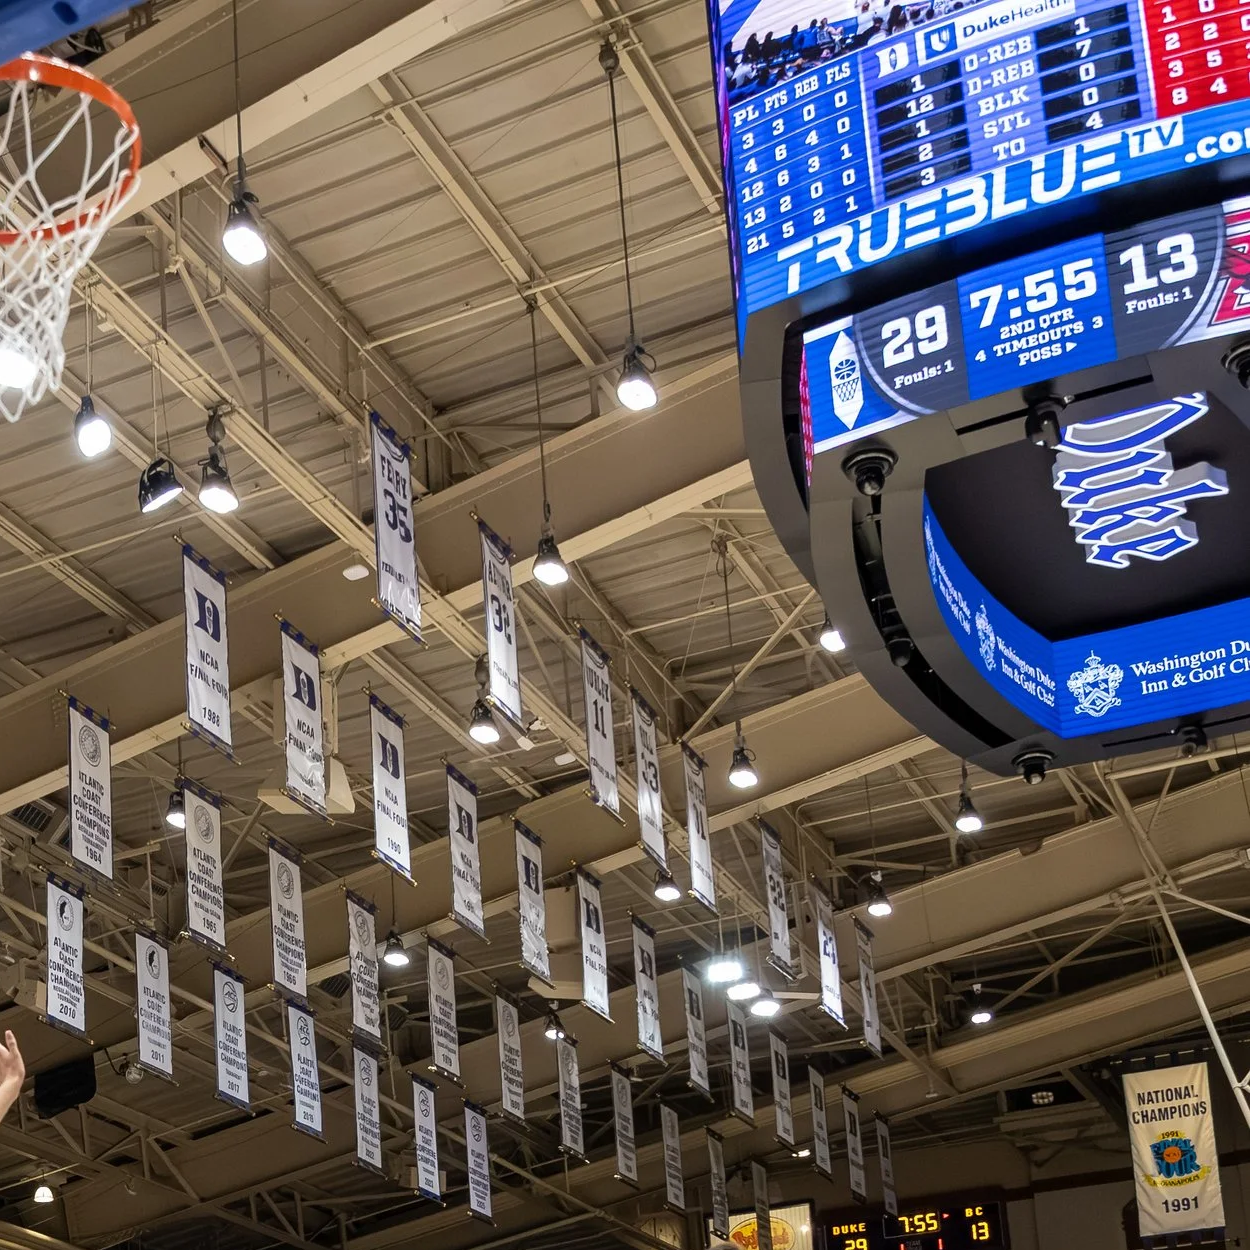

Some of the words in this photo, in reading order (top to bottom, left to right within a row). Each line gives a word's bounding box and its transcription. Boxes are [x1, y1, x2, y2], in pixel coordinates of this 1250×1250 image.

[962, 0, 1067, 38] DukeHealth
[1162, 6, 1176, 23] 1
[911, 75, 925, 92] 1
[964, 35, 1032, 72] O-REB
[1074, 17, 1090, 36] 1
[1165, 32, 1181, 51] 2
[1203, 22, 1219, 41] 2
[906, 94, 935, 118] 12
[967, 59, 1035, 96] D-REB
[1076, 39, 1092, 58] 7
[1168, 59, 1183, 78] 3
[1206, 49, 1222, 68] 5
[733, 103, 759, 127] PL
[764, 90, 788, 113] PTS
[794, 75, 819, 99] REB
[826, 62, 850, 85] FLS
[916, 120, 930, 138] 1
[977, 86, 1030, 117] BLK
[1079, 62, 1095, 82] 0
[1172, 87, 1188, 105] 8
[1210, 77, 1227, 94] 4
[742, 133, 754, 150] 3
[772, 118, 784, 135] 3
[803, 104, 815, 121] 0
[835, 91, 847, 107] 0
[919, 143, 933, 162] 2
[983, 112, 1030, 139] STL
[1082, 87, 1099, 106] 0
[744, 158, 757, 173] 4
[775, 144, 787, 161] 6
[806, 130, 819, 146] 4
[837, 117, 850, 134] 0
[920, 167, 935, 186] 3
[993, 138, 1025, 161] TO
[1086, 112, 1103, 130] 4
[742, 181, 764, 202] 12
[777, 170, 789, 187] 6
[808, 156, 820, 173] 3
[840, 144, 852, 160] 1
[744, 206, 766, 228] 13
[780, 196, 792, 212] 2
[811, 181, 823, 198] 0
[842, 169, 855, 186] 0
[777, 132, 1122, 294] TRUEBLUE
[1132, 120, 1180, 154] TV
[747, 233, 770, 255] 21
[782, 221, 794, 238] 5
[813, 208, 825, 225] 2
[846, 196, 858, 212] 1
[1118, 233, 1198, 295] 13
[969, 258, 1097, 329] 7:55
[1125, 290, 1179, 315] Fouls:
[1182, 286, 1194, 301] 1
[881, 304, 949, 368] 29
[975, 350, 986, 363] 4
[993, 321, 1084, 356] TIMEOUTS
[1093, 316, 1104, 329] 3
[1000, 317, 1036, 340] 2ND
[1039, 307, 1075, 330] QTR
[894, 362, 943, 389] Fouls:
[943, 360, 954, 375] 1
[1018, 344, 1062, 367] POSS
[384, 488, 413, 544] 35
[200, 648, 219, 673] NCAA
[996, 636, 1035, 679] Washington
[1036, 667, 1056, 691] Duke
[1130, 646, 1226, 677] Washington
[1141, 679, 1168, 695] Inn
[1171, 672, 1188, 688] &
[1188, 663, 1226, 683] Golf
[593, 698, 607, 740] 11
[1132, 1100, 1207, 1125] CHAMPIONS
[1137, 1084, 1199, 1106] NATIONAL
[1161, 1130, 1179, 1139] 1991
[832, 1222, 867, 1236] DUKE
[898, 1213, 938, 1233] 7:55
[1162, 1196, 1199, 1213] 1991
[972, 1222, 989, 1241] 13
